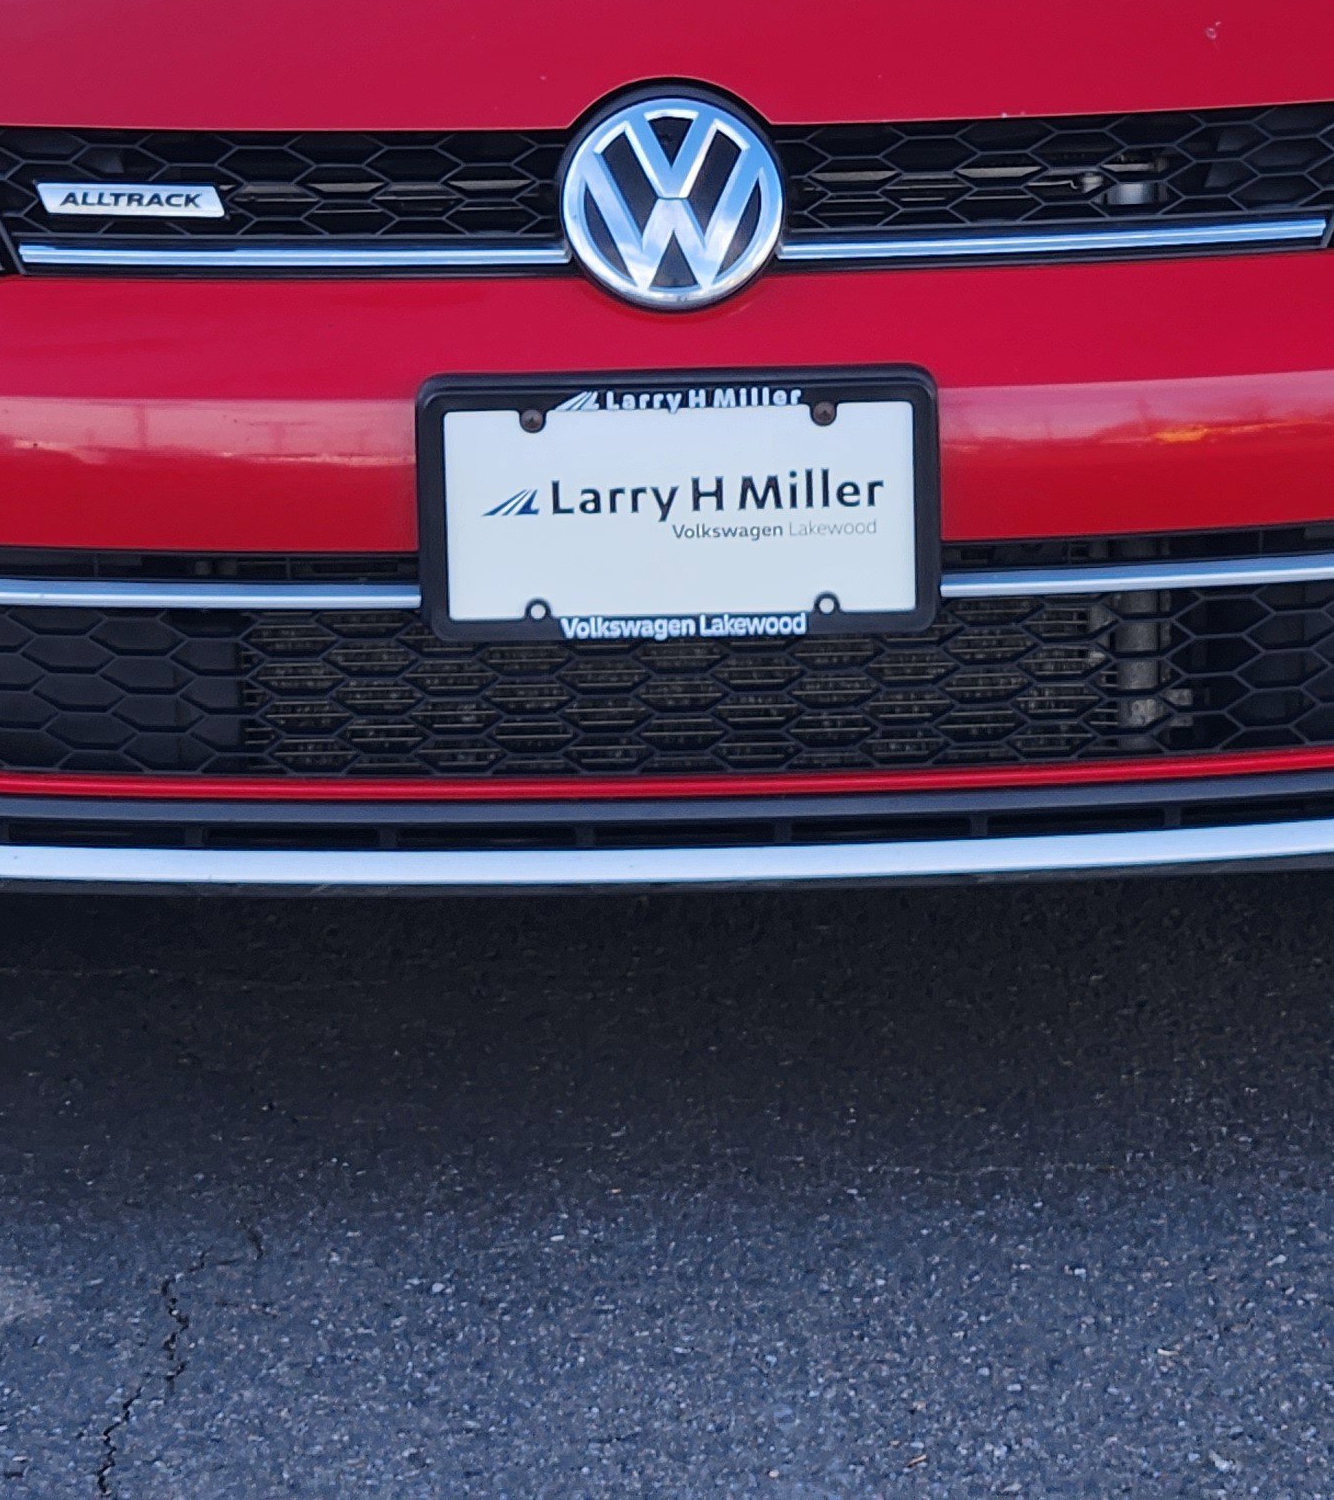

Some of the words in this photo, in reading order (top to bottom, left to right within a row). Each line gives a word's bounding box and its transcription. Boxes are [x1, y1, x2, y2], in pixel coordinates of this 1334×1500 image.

[60, 192, 200, 208] ALLTRACK
[569, 103, 775, 299] VW
[605, 390, 682, 414] Larry
[688, 388, 706, 408] H
[713, 386, 802, 408] Miller
[551, 480, 679, 522] Larry
[692, 476, 724, 511] H
[738, 468, 885, 512] Miller
[672, 524, 783, 541] Volkswagen
[789, 519, 877, 536] Lakewood
[560, 617, 696, 641] Volkswagen
[699, 612, 806, 637] Lakewood
